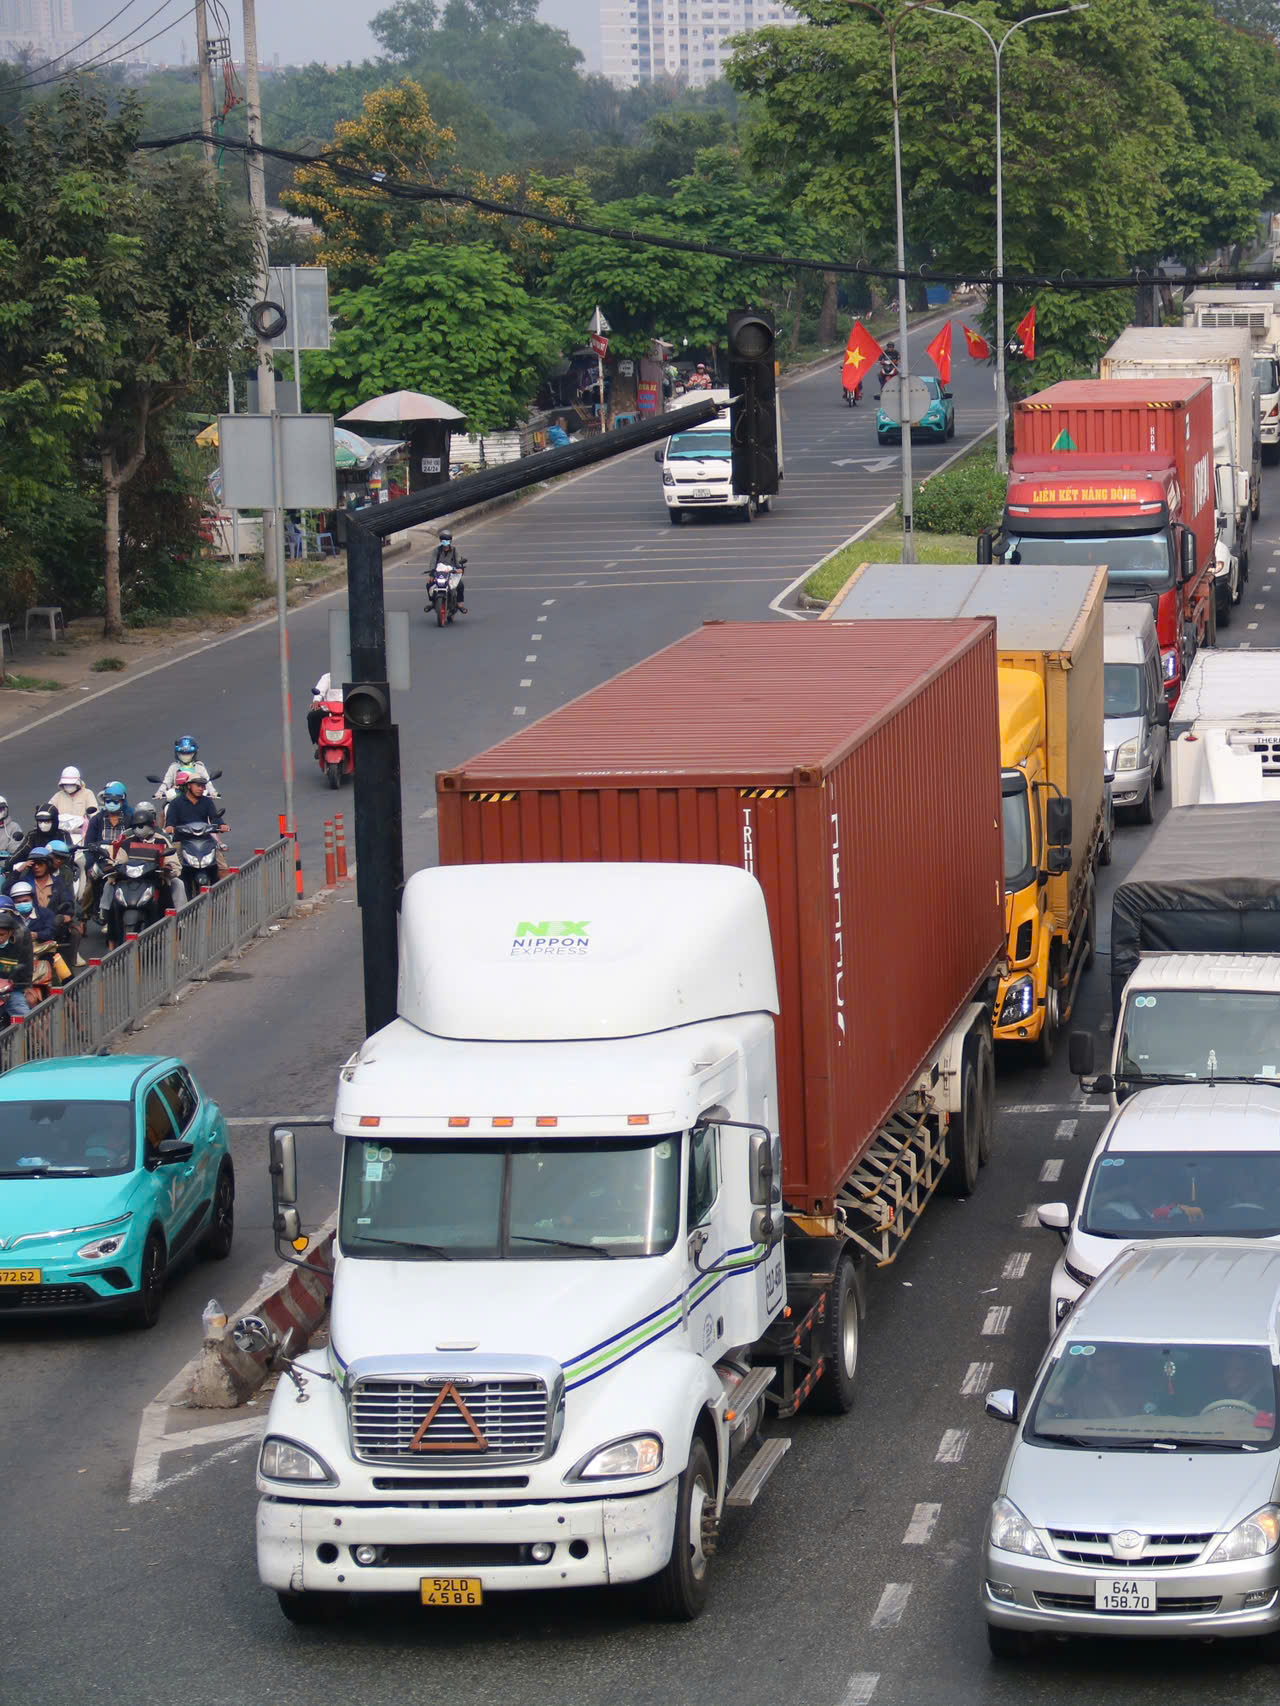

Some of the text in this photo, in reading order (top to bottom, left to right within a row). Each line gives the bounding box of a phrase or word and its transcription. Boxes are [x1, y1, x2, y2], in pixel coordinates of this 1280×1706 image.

[1033, 487, 1056, 502] LIÊN
[512, 937, 590, 947] NIPPON
[510, 946, 588, 957] EXPRESS
[0, 1271, 35, 1282] 72.62
[433, 1579, 469, 1591] 52LD
[1112, 1581, 1138, 1595] 64A
[427, 1592, 475, 1604] 4586
[1103, 1595, 1150, 1609] 158.70
